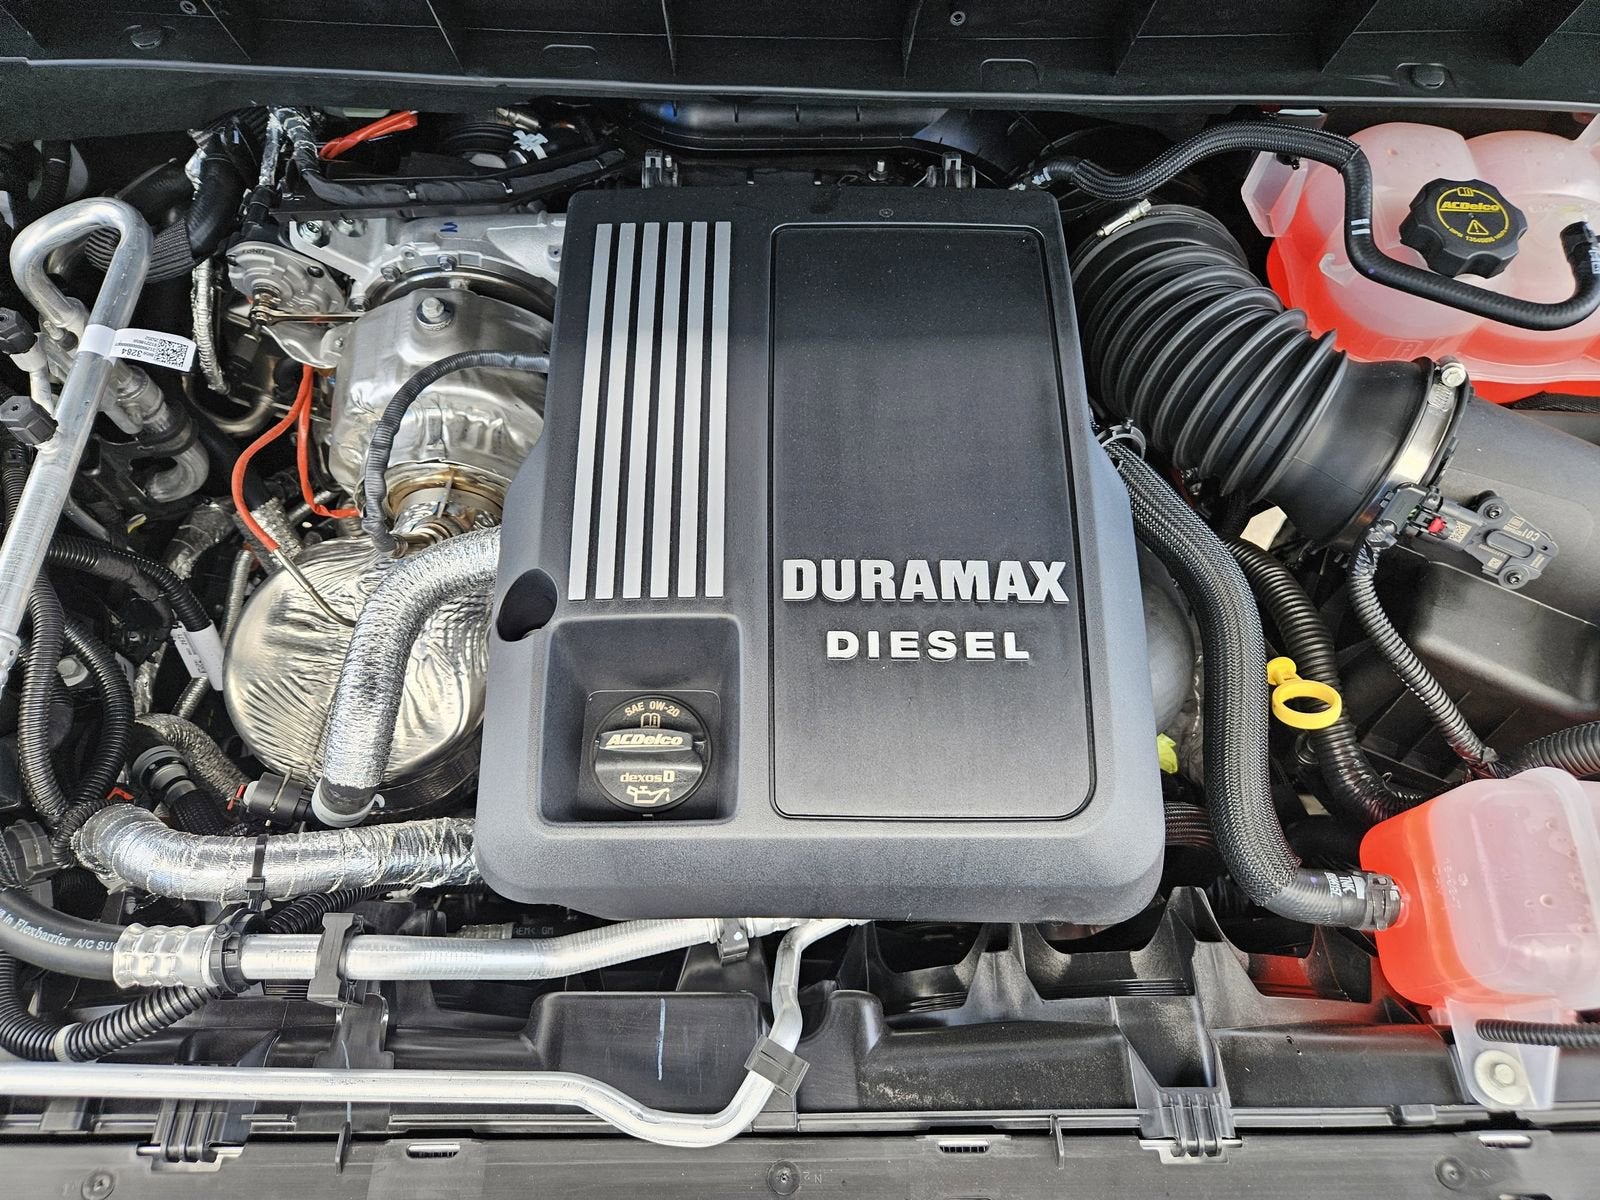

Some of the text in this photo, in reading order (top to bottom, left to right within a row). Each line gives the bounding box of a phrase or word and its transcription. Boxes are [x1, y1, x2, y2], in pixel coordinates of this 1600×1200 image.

[1441, 201, 1500, 212] ACDelco
[782, 559, 1070, 604] DURAMAX
[826, 630, 1030, 661] DIESEL
[624, 700, 681, 718] SAE 0W-20
[605, 733, 684, 746] ACDelco
[619, 769, 675, 783] dexosD
[13, 918, 71, 947] Flexbarrier
[73, 938, 94, 950] A/C
